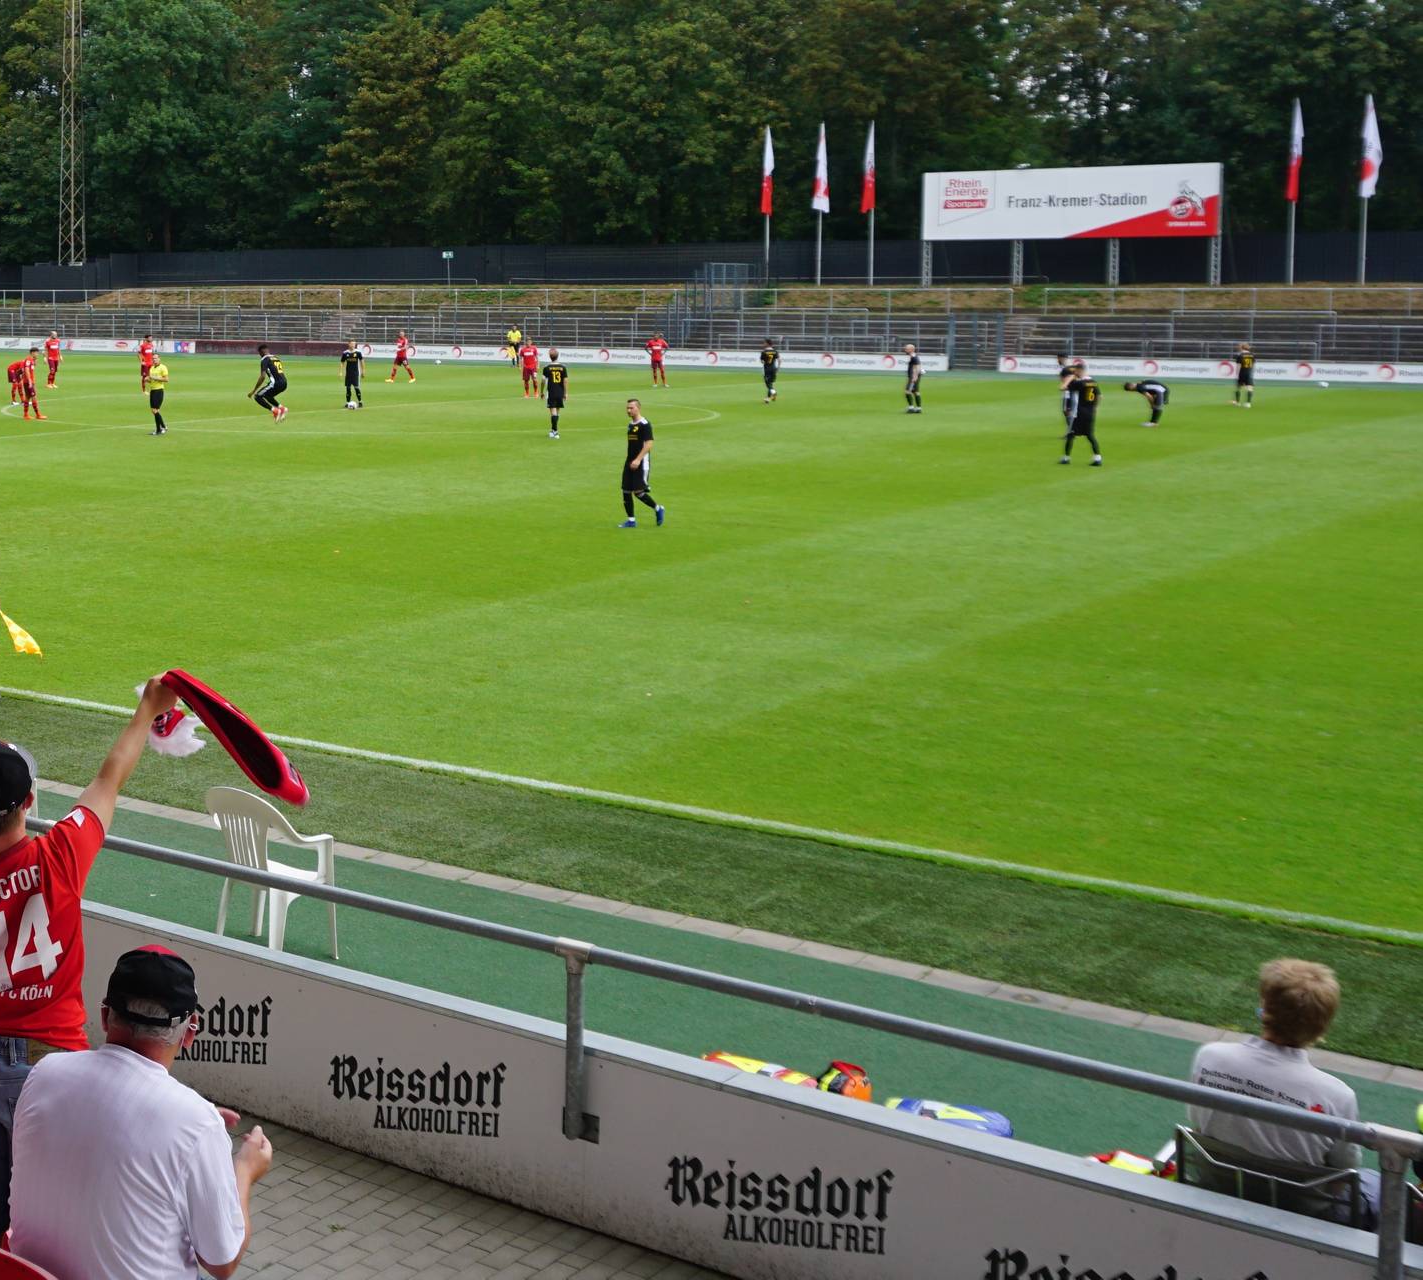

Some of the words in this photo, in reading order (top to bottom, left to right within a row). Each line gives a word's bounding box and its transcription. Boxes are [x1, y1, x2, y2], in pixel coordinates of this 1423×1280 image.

[945, 187, 989, 198] Energie
[949, 178, 982, 188] Rhein
[1008, 194, 1147, 208] Franz-Kremer-Stadion
[552, 371, 562, 383] 13
[20, 984, 54, 1001] KÖLN
[195, 996, 273, 1038] sdorf
[174, 1039, 268, 1065] KOHOLFREI
[328, 1053, 508, 1109] Reissdorf
[1201, 1067, 1244, 1085] Deutsches
[1246, 1079, 1275, 1096] Rotes
[373, 1104, 500, 1138] ALKOHOLFREI
[664, 1155, 896, 1222] Reissdorf
[723, 1213, 886, 1255] ALKOHOLFREI
